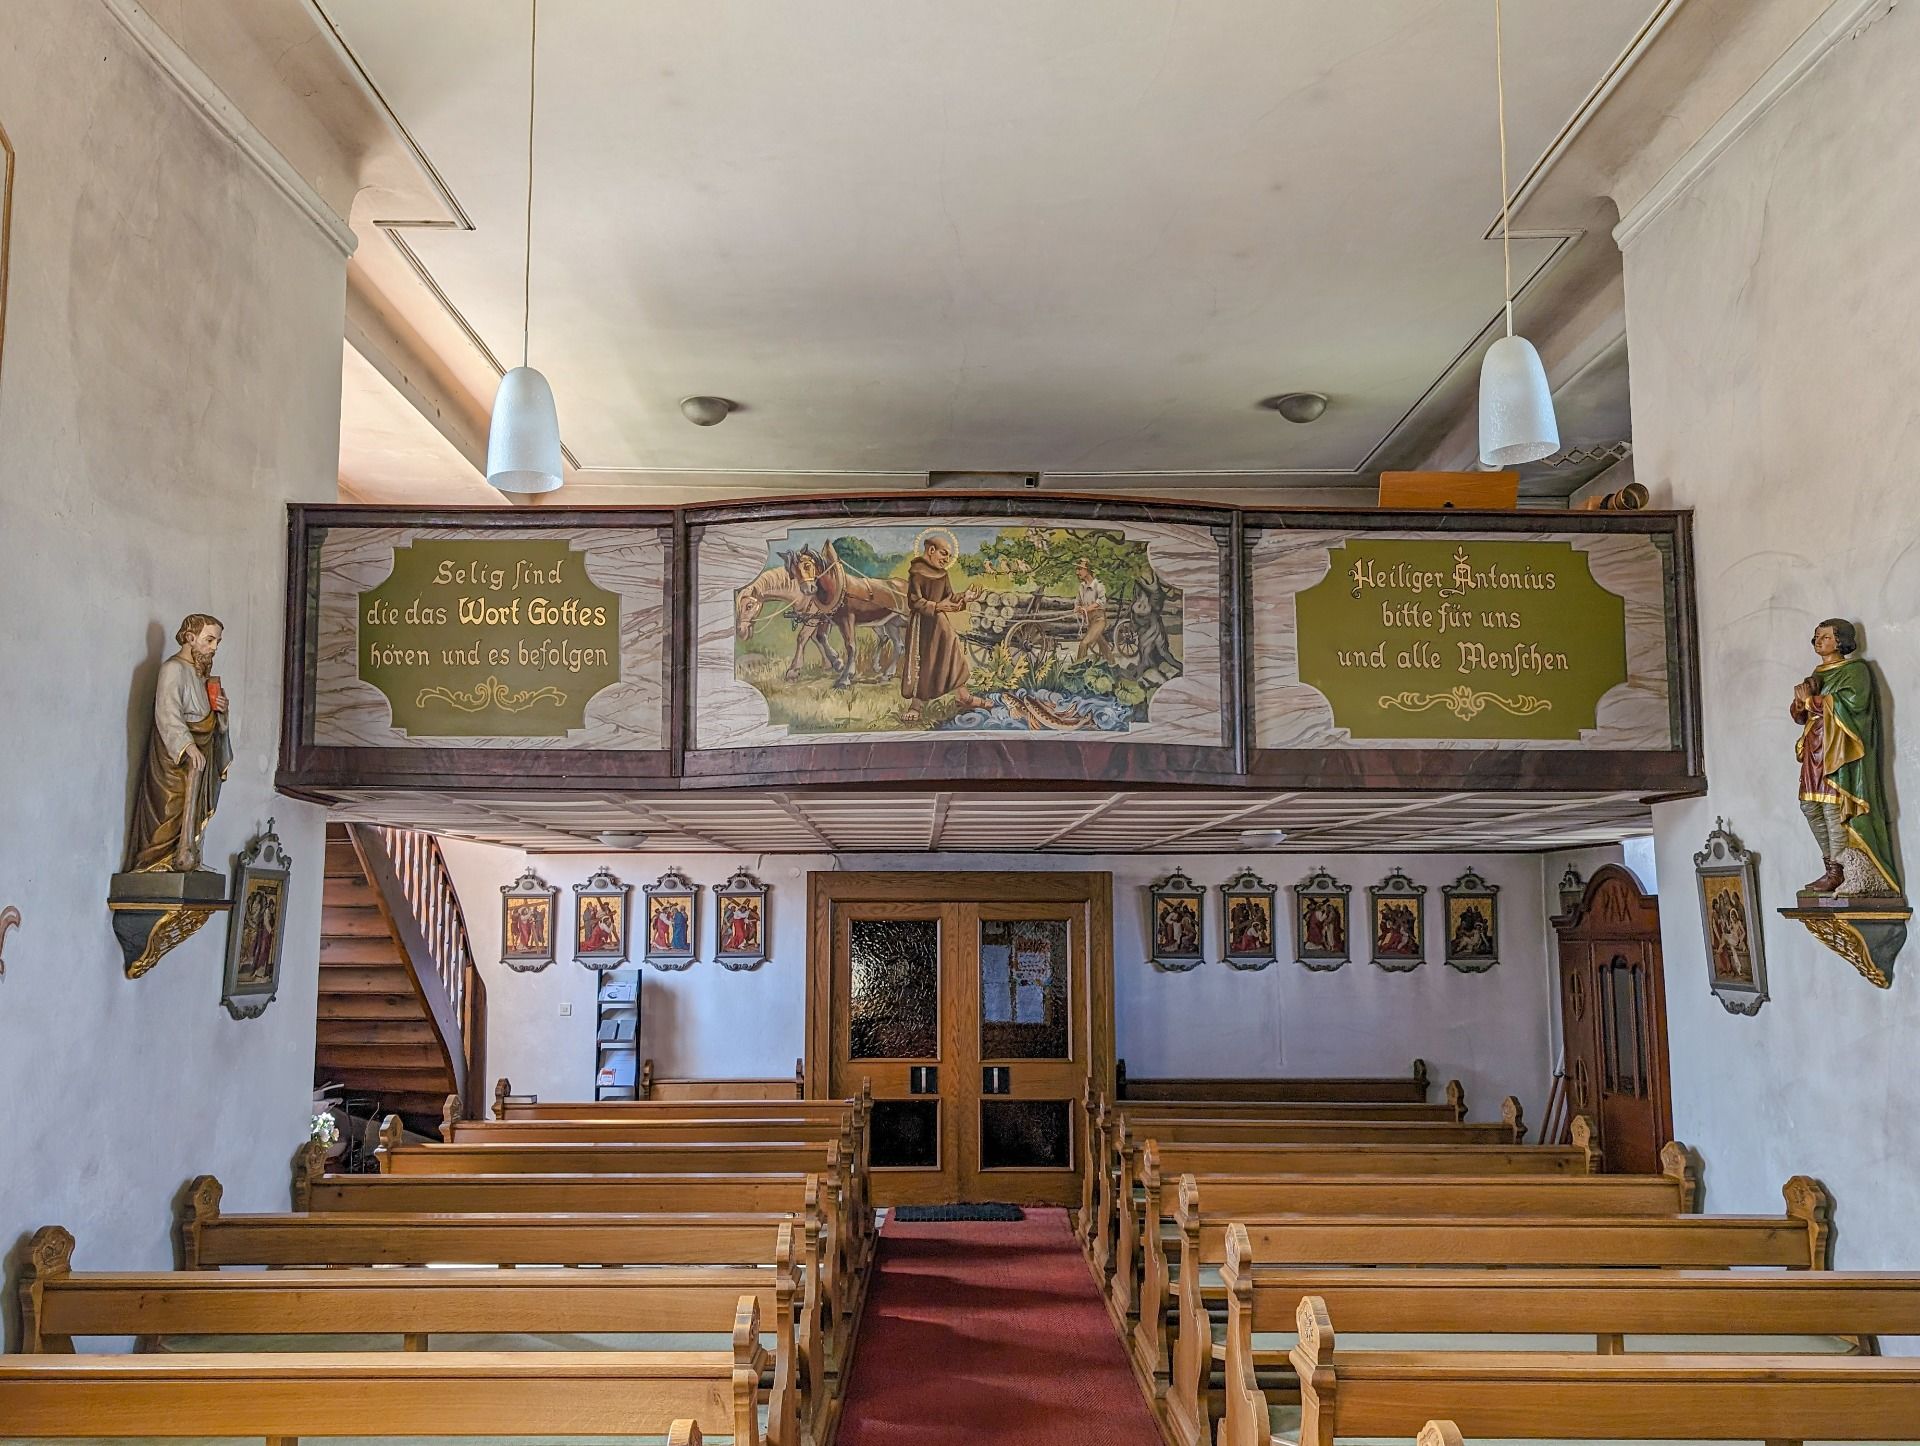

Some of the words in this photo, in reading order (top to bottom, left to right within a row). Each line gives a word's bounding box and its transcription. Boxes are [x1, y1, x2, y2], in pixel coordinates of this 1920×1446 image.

[432, 560, 505, 590] Selig
[1349, 558, 1443, 598] Heiliger
[1439, 552, 1556, 598] Antonius
[367, 599, 398, 626] die
[404, 595, 448, 626] das
[457, 597, 520, 626] Wort
[527, 597, 607, 627] Gottes
[1381, 600, 1433, 629] bitte
[1438, 602, 1473, 633] für
[1480, 610, 1521, 630] uns
[370, 641, 430, 668] hören
[441, 638, 482, 667] und
[488, 646, 511, 667] es
[518, 638, 609, 673] befolgen
[1337, 641, 1387, 669] und
[1397, 641, 1442, 669] alle
